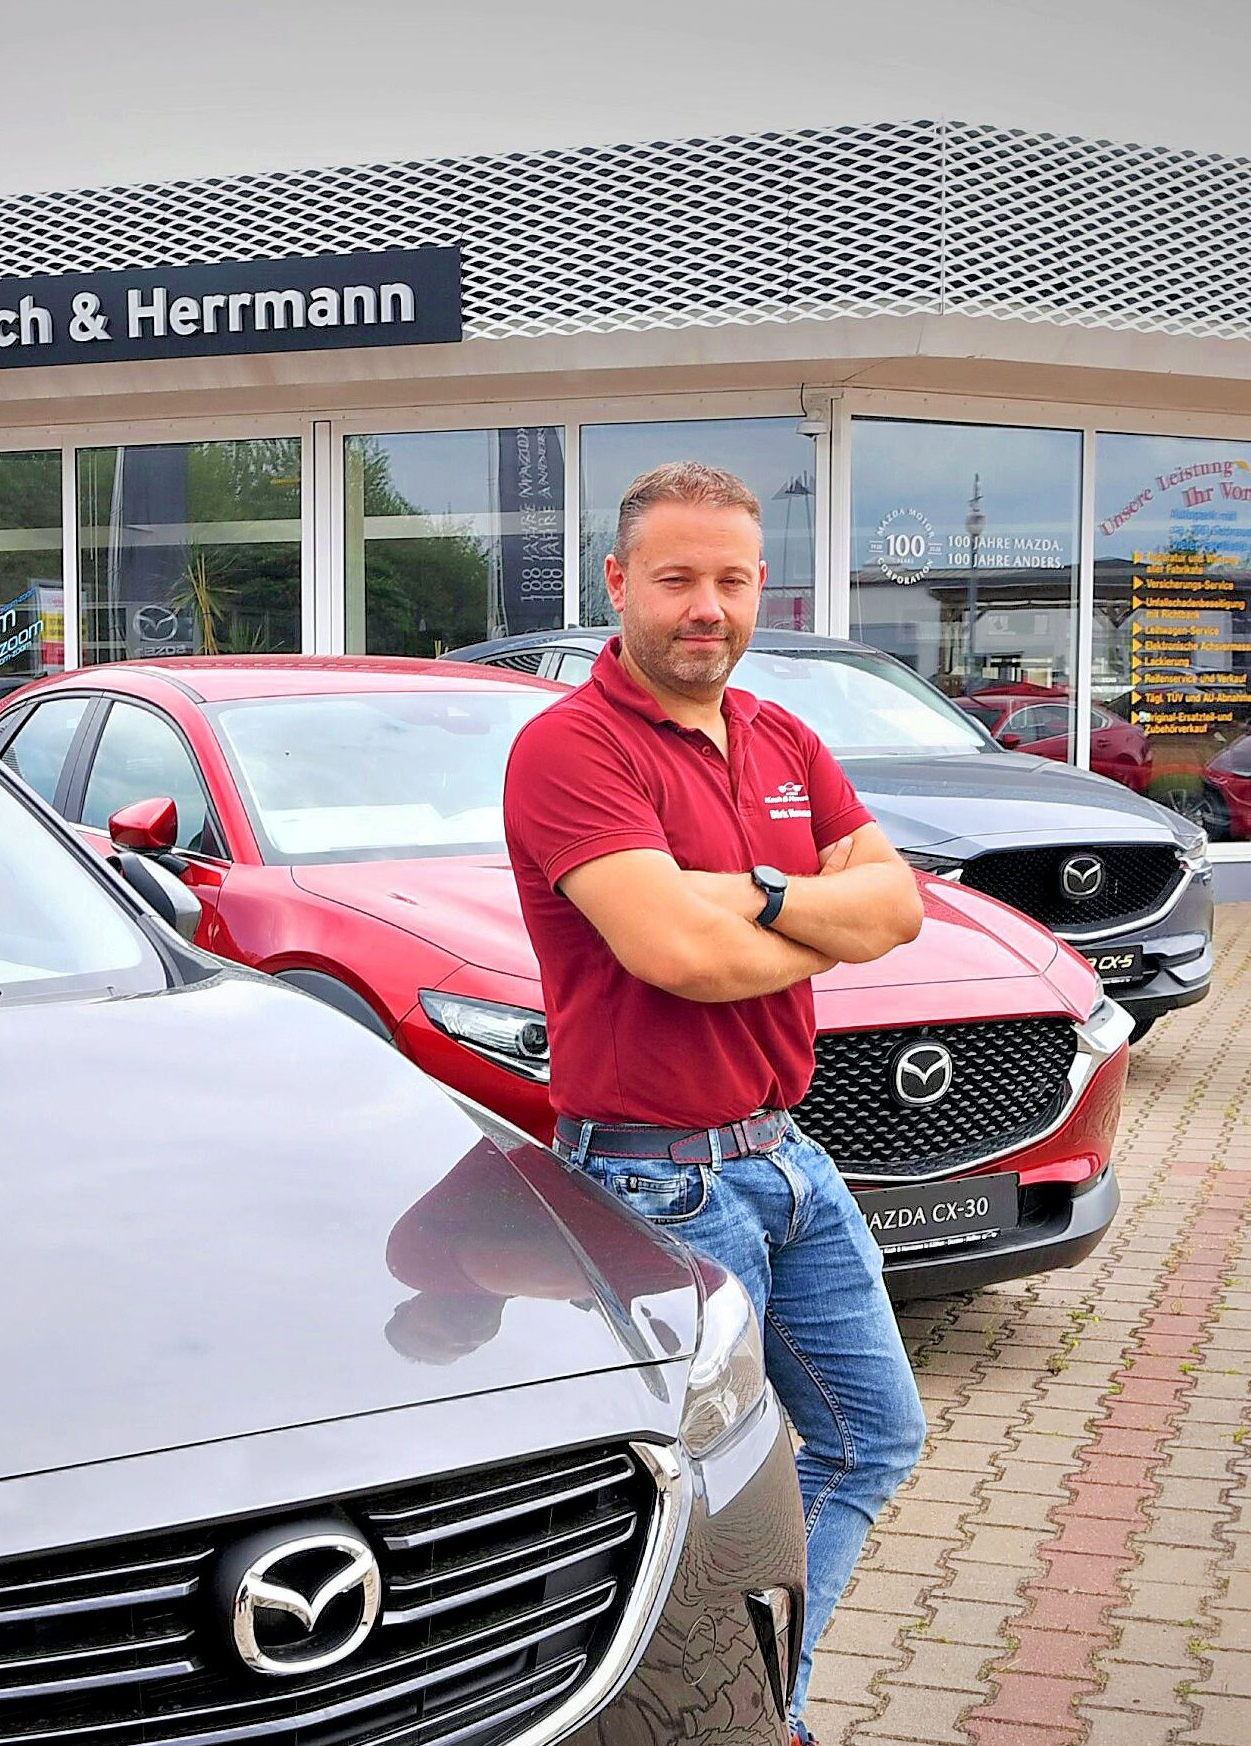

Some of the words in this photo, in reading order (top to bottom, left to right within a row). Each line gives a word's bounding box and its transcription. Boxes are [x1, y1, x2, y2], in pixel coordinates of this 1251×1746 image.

[69, 291, 112, 342] &
[128, 282, 415, 338] Herrmann
[1100, 488, 1154, 536] Unsere
[1156, 460, 1234, 491] Leistung
[1182, 486, 1214, 507] Ihr
[876, 508, 905, 537] MAZDA
[908, 508, 936, 539] MOTOR
[886, 535, 925, 557] 100
[948, 535, 970, 548] 100
[973, 536, 1010, 550] JAHRE
[1013, 538, 1064, 552] MAZDA.
[948, 553, 970, 565] 100
[973, 553, 1010, 568] JAHRE
[1013, 555, 1065, 569] ANDERS.
[877, 557, 932, 585] CORPORATION
[1145, 577, 1235, 592] Versicherungs-Service
[1145, 656, 1191, 668] Lackierung
[1199, 674, 1215, 683] und
[1216, 673, 1248, 684] Verkauf
[1185, 694, 1201, 702] und
[1144, 723, 1209, 734] Zubehörverkauf
[1098, 953, 1135, 970] CX-5
[932, 1196, 989, 1223] CX-30
